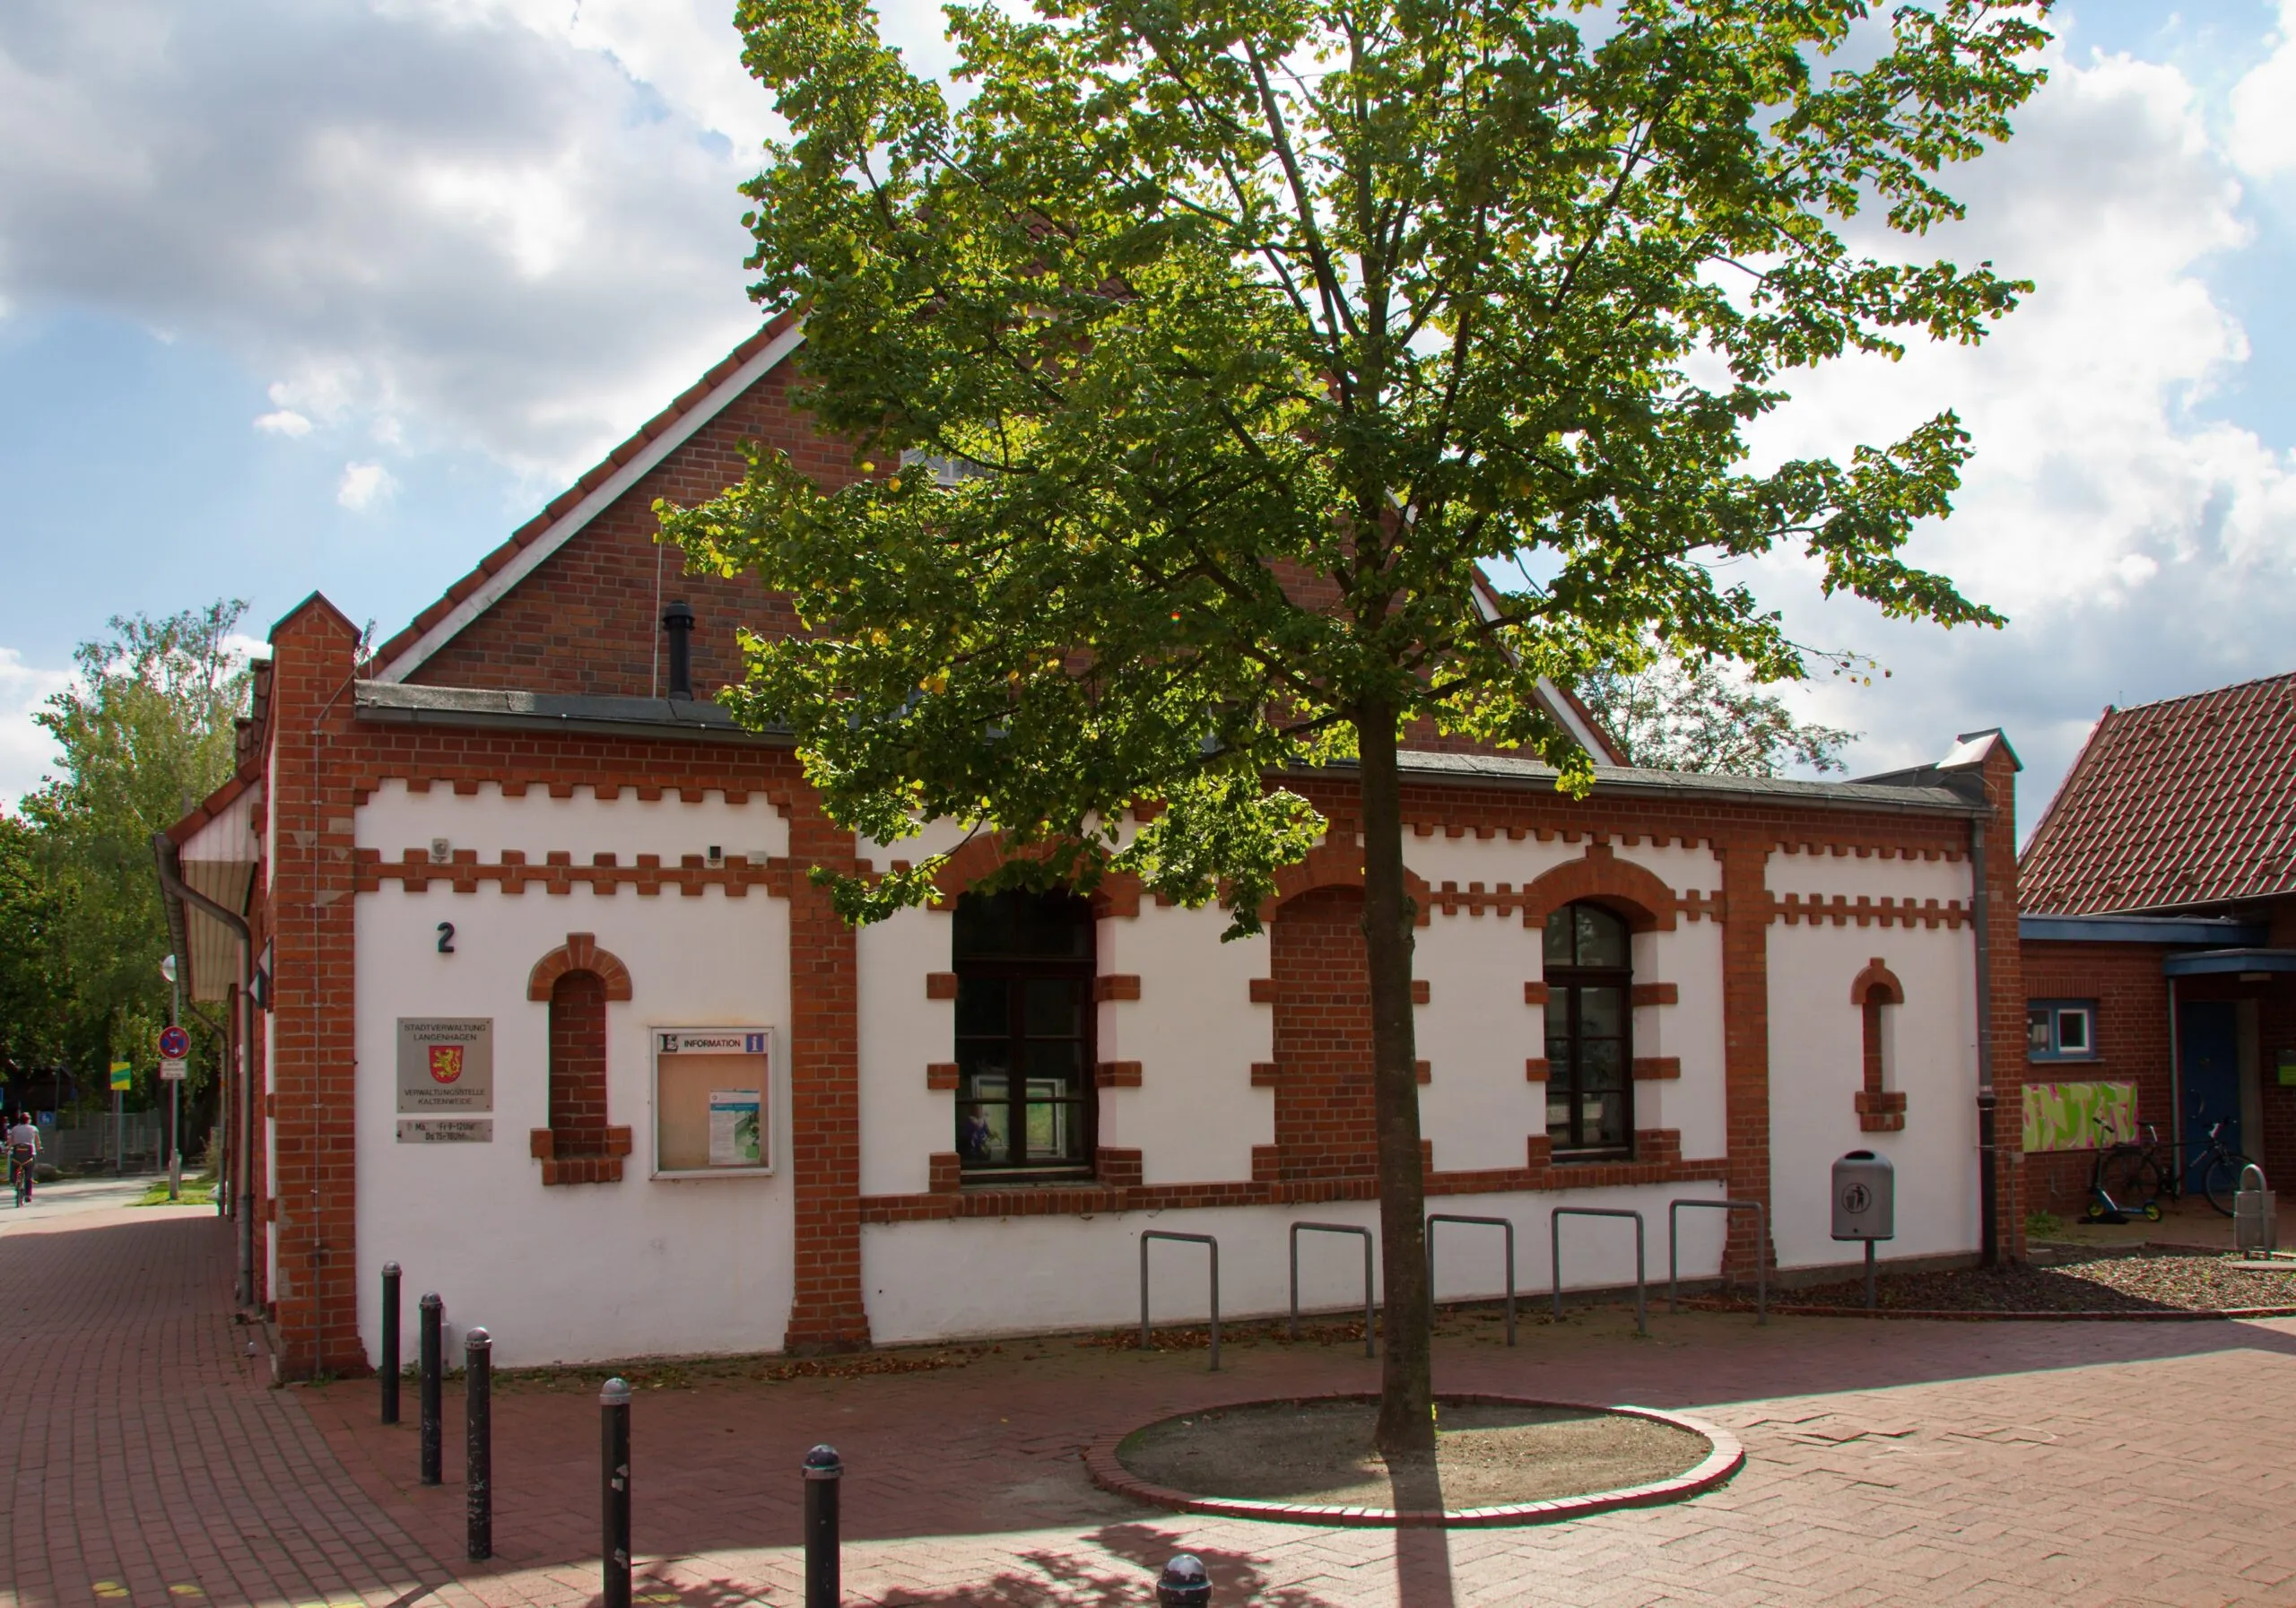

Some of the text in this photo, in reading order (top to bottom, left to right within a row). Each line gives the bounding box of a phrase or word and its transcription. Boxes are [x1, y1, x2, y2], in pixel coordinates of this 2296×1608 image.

[437, 921, 455, 953] 2
[404, 1023, 485, 1031] STADTVERWALTUNG
[413, 1033, 477, 1041] LANGENHAGEN
[684, 1039, 741, 1047] INFORMATION
